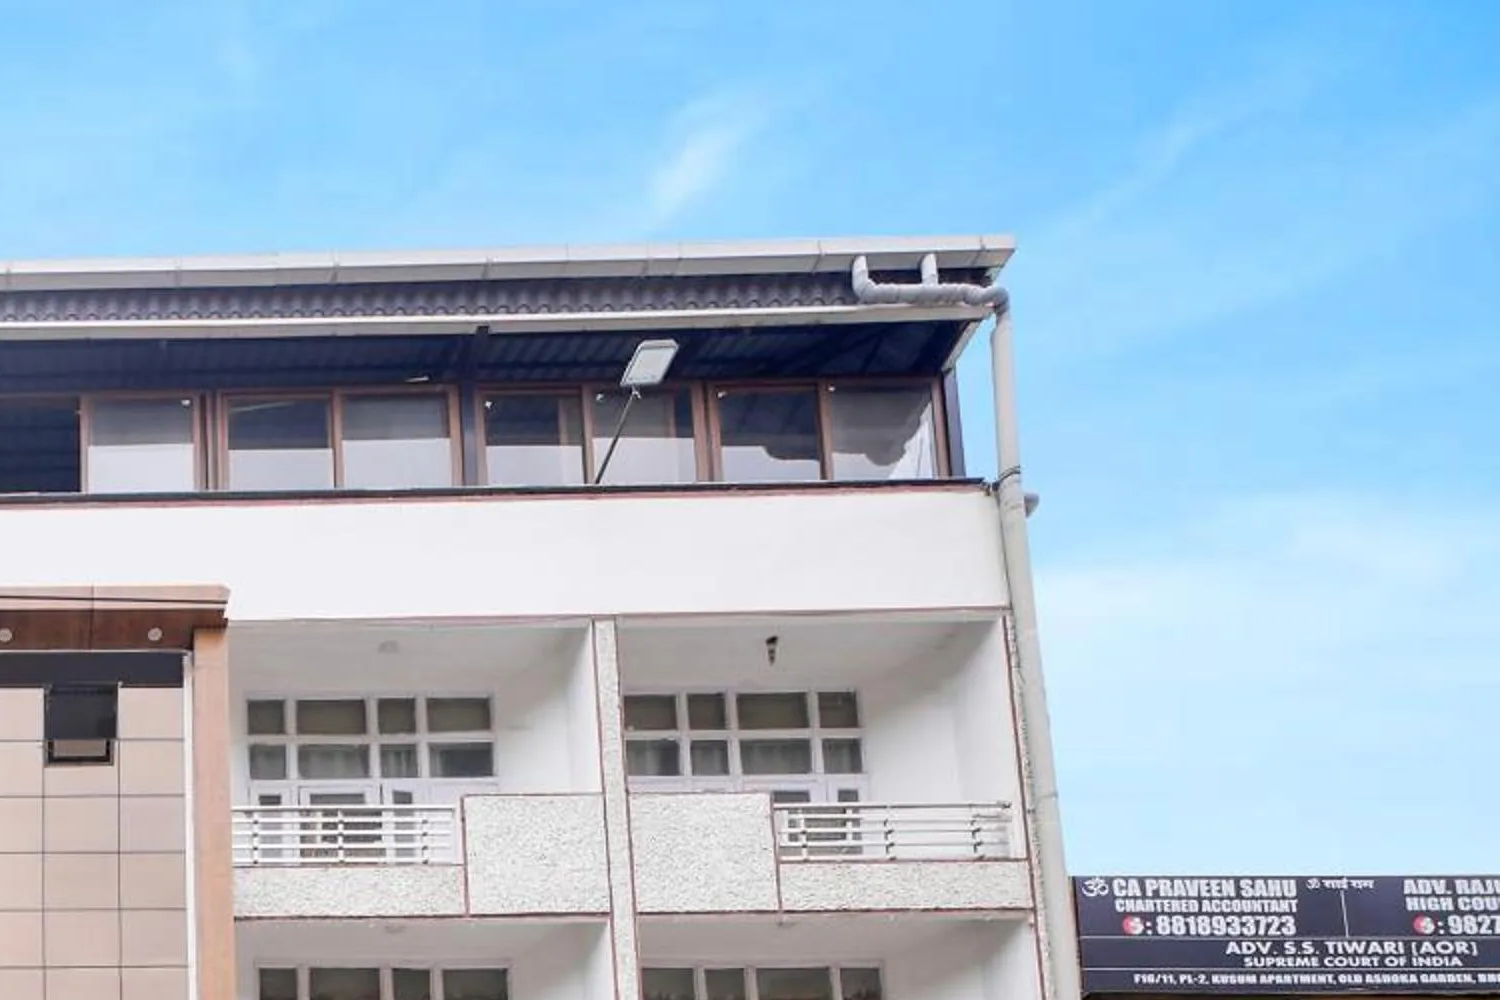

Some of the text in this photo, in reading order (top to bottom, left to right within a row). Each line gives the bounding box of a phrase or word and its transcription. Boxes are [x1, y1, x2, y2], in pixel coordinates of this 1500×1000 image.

[1112, 878, 1298, 898] CA PRAVEEN SAHU
[1403, 879, 1451, 895] ADV.
[1115, 899, 1298, 913] CHARTERED ACCOUNTANT
[1406, 896, 1500, 911] HIGH COU
[1156, 915, 1297, 936] 8818933723
[1226, 941, 1278, 955] ADV.
[1283, 941, 1320, 955] S.S.
[1324, 941, 1404, 955] TIWARI
[1244, 956, 1463, 967] SUPREME COURT OF INDIA
